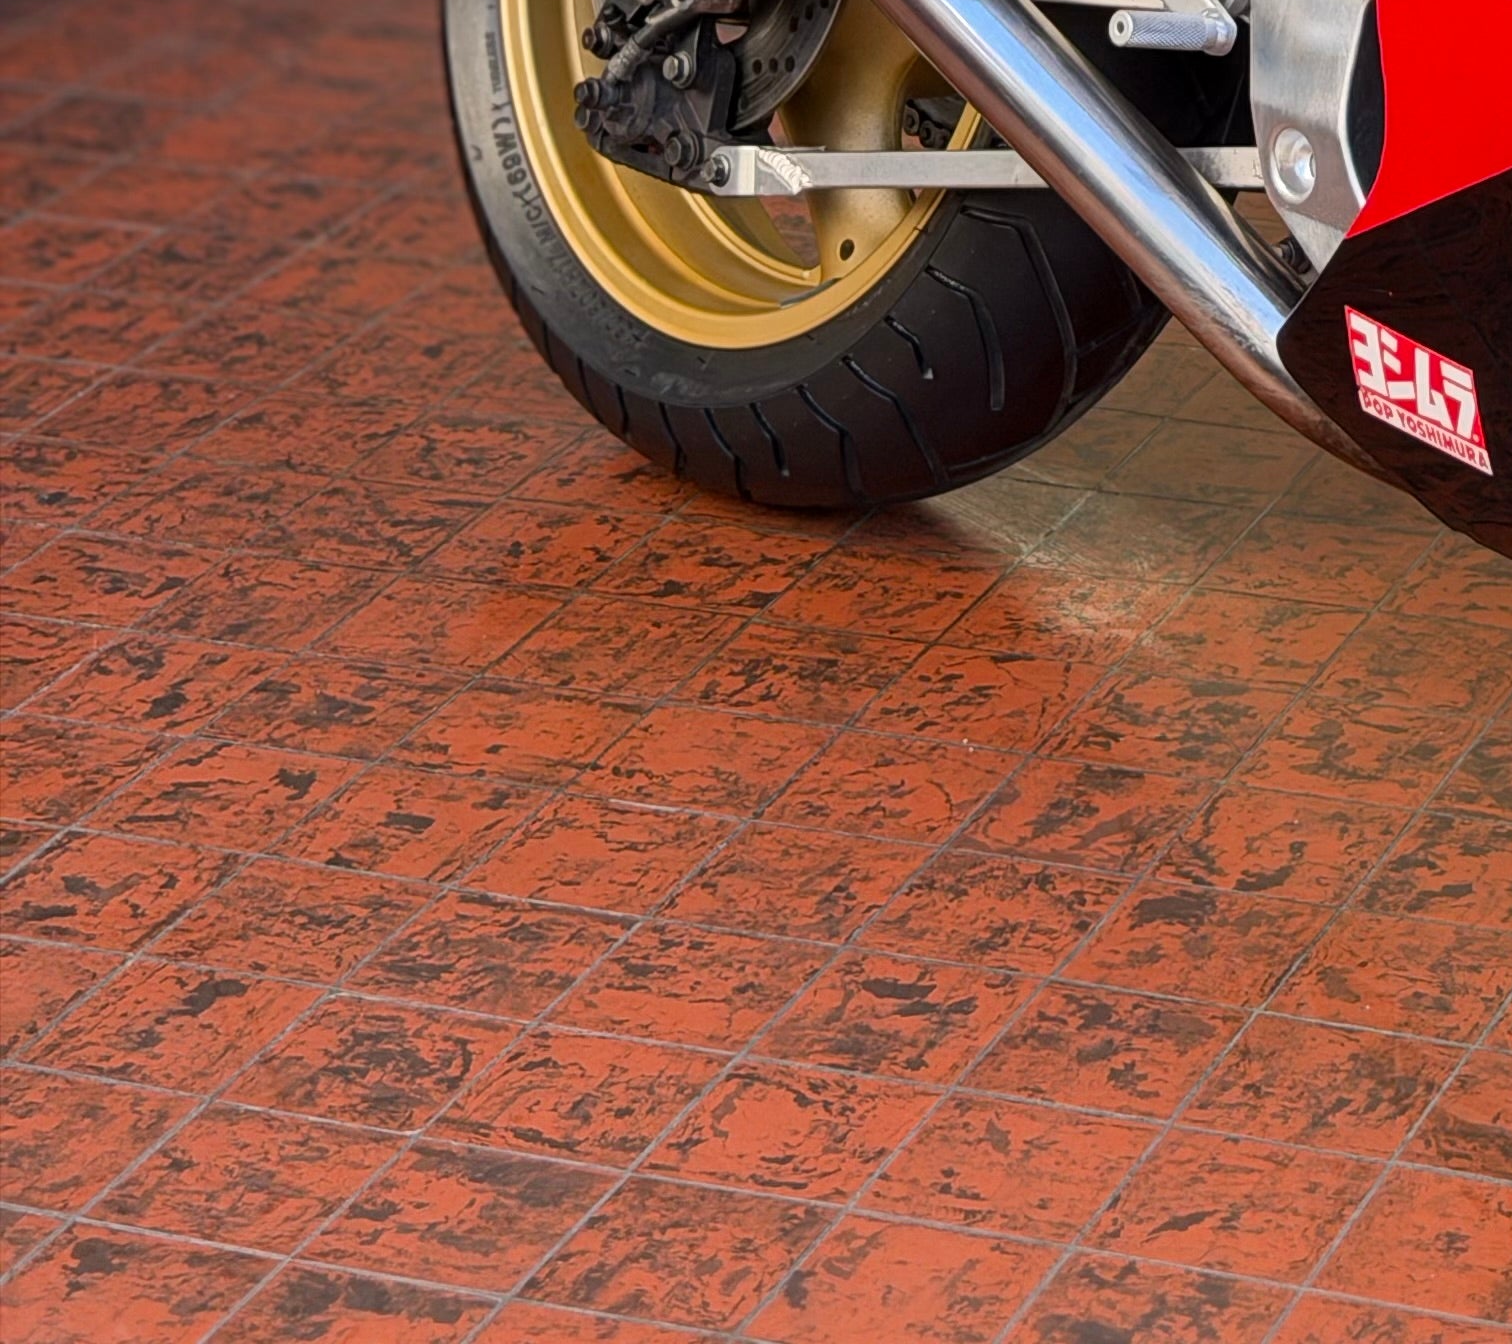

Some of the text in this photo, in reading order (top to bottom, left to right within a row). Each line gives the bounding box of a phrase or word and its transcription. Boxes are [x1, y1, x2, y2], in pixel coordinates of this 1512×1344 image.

[1350, 312, 1477, 438] ヨシムラ
[1364, 389, 1488, 469] POP YOSHIMURA
